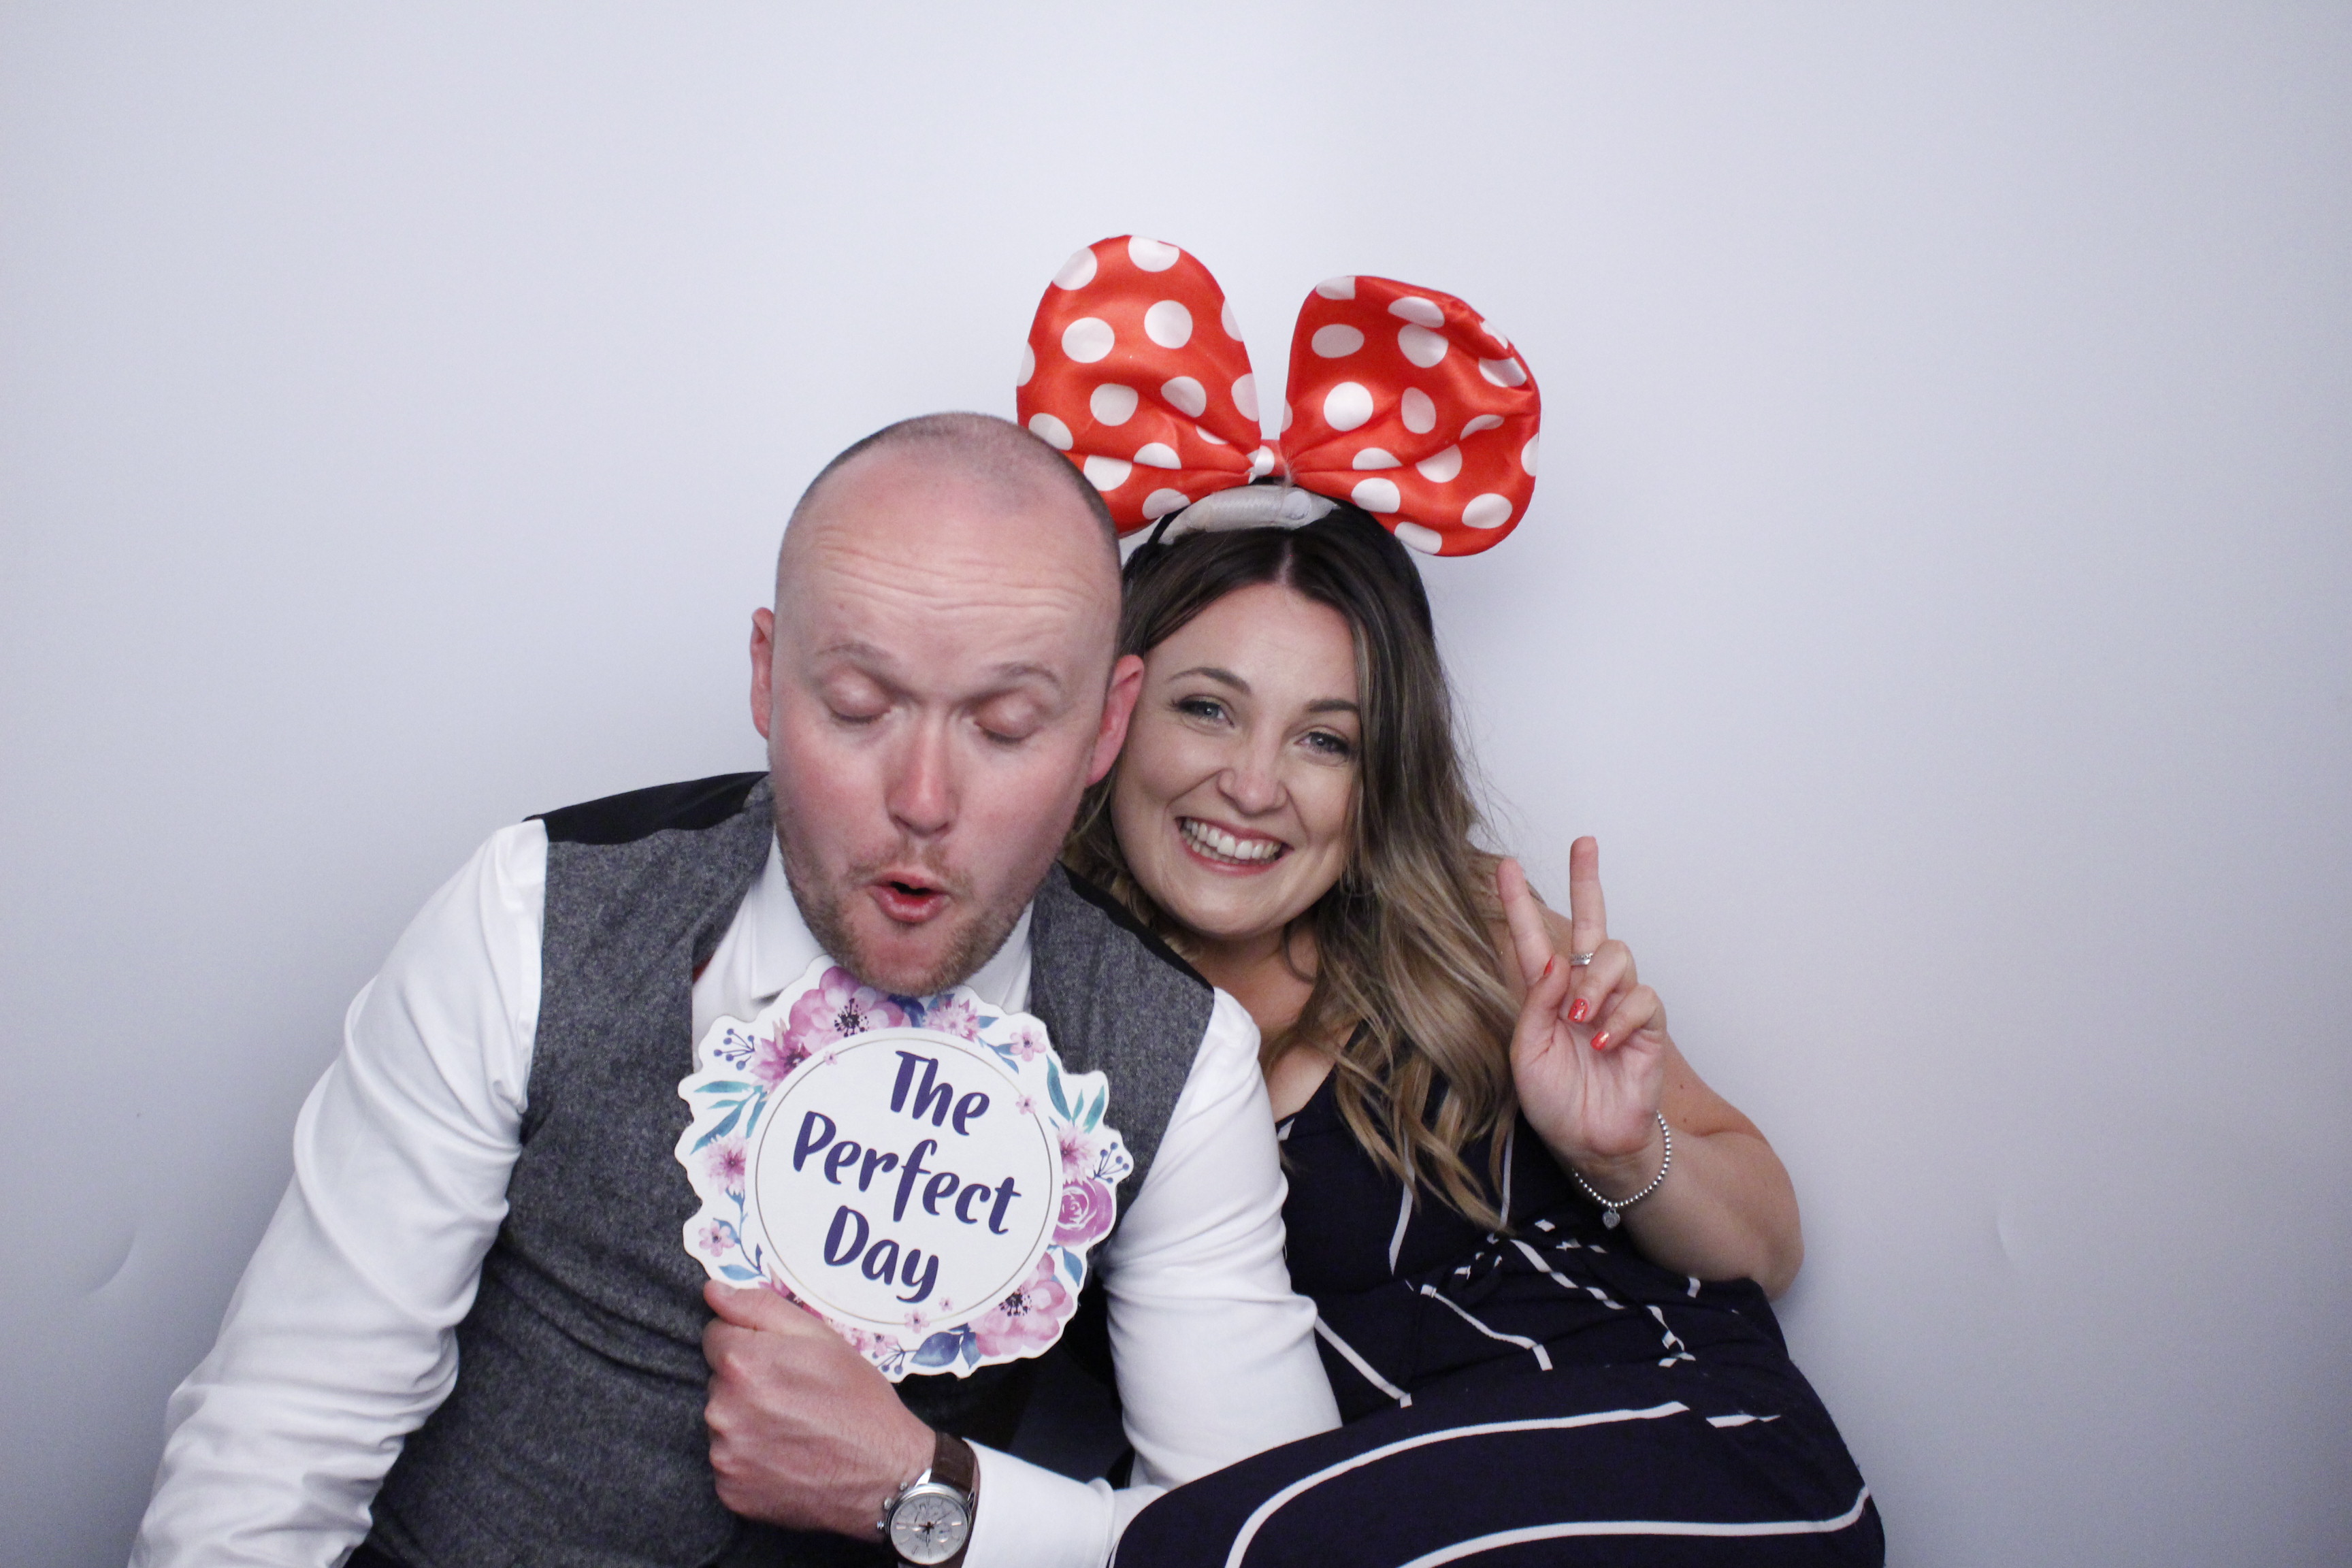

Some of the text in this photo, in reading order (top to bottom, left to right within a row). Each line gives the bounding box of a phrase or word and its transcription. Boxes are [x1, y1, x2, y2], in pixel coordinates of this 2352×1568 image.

[890, 1050, 990, 1136] The
[793, 1111, 1022, 1235] Perfect
[823, 1205, 939, 1303] Day
